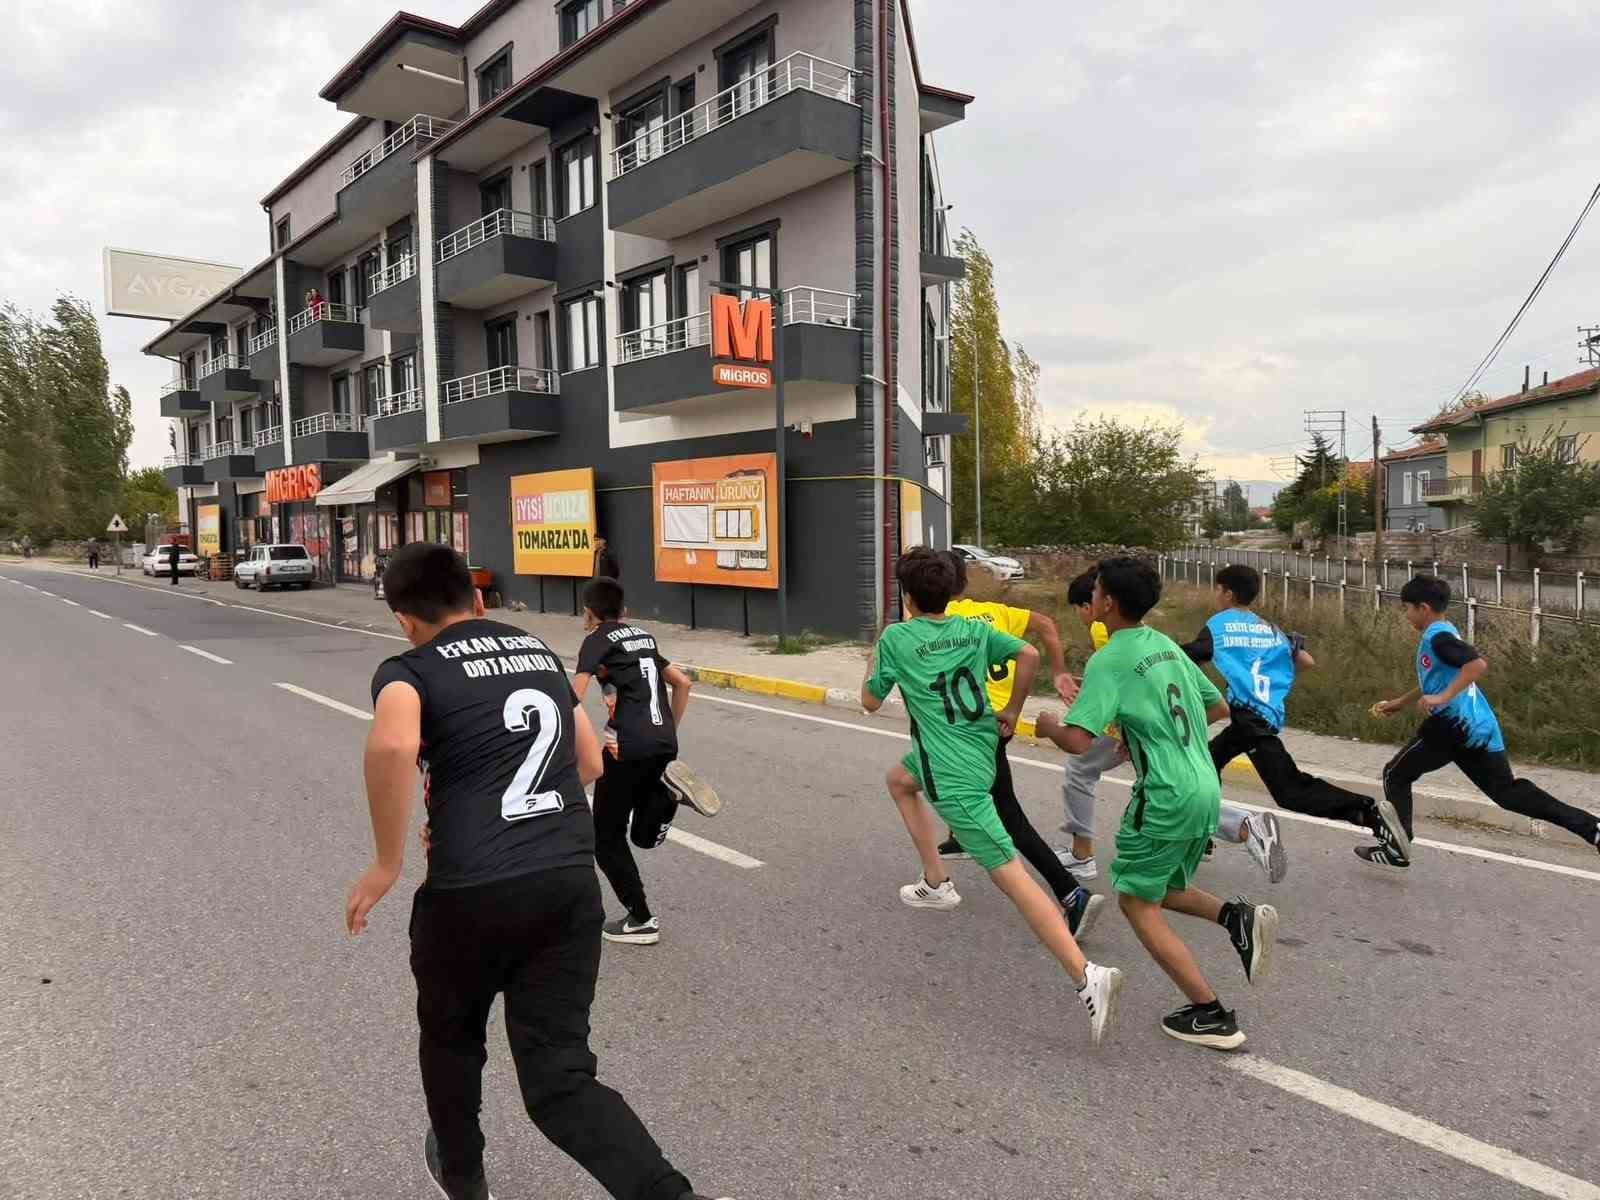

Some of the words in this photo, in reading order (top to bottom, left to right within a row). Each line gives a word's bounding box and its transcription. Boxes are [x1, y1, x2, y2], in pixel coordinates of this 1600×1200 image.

[127, 271, 224, 297] AYGA
[711, 294, 773, 362] M
[665, 487, 715, 501] HAFTANIN
[518, 529, 589, 549] TOMARZA'DA
[436, 637, 501, 659] EFKAN
[639, 657, 663, 726] 7
[929, 665, 984, 725] 10
[1250, 657, 1271, 703] 6
[1166, 682, 1190, 747] 6
[501, 688, 564, 821] 2
